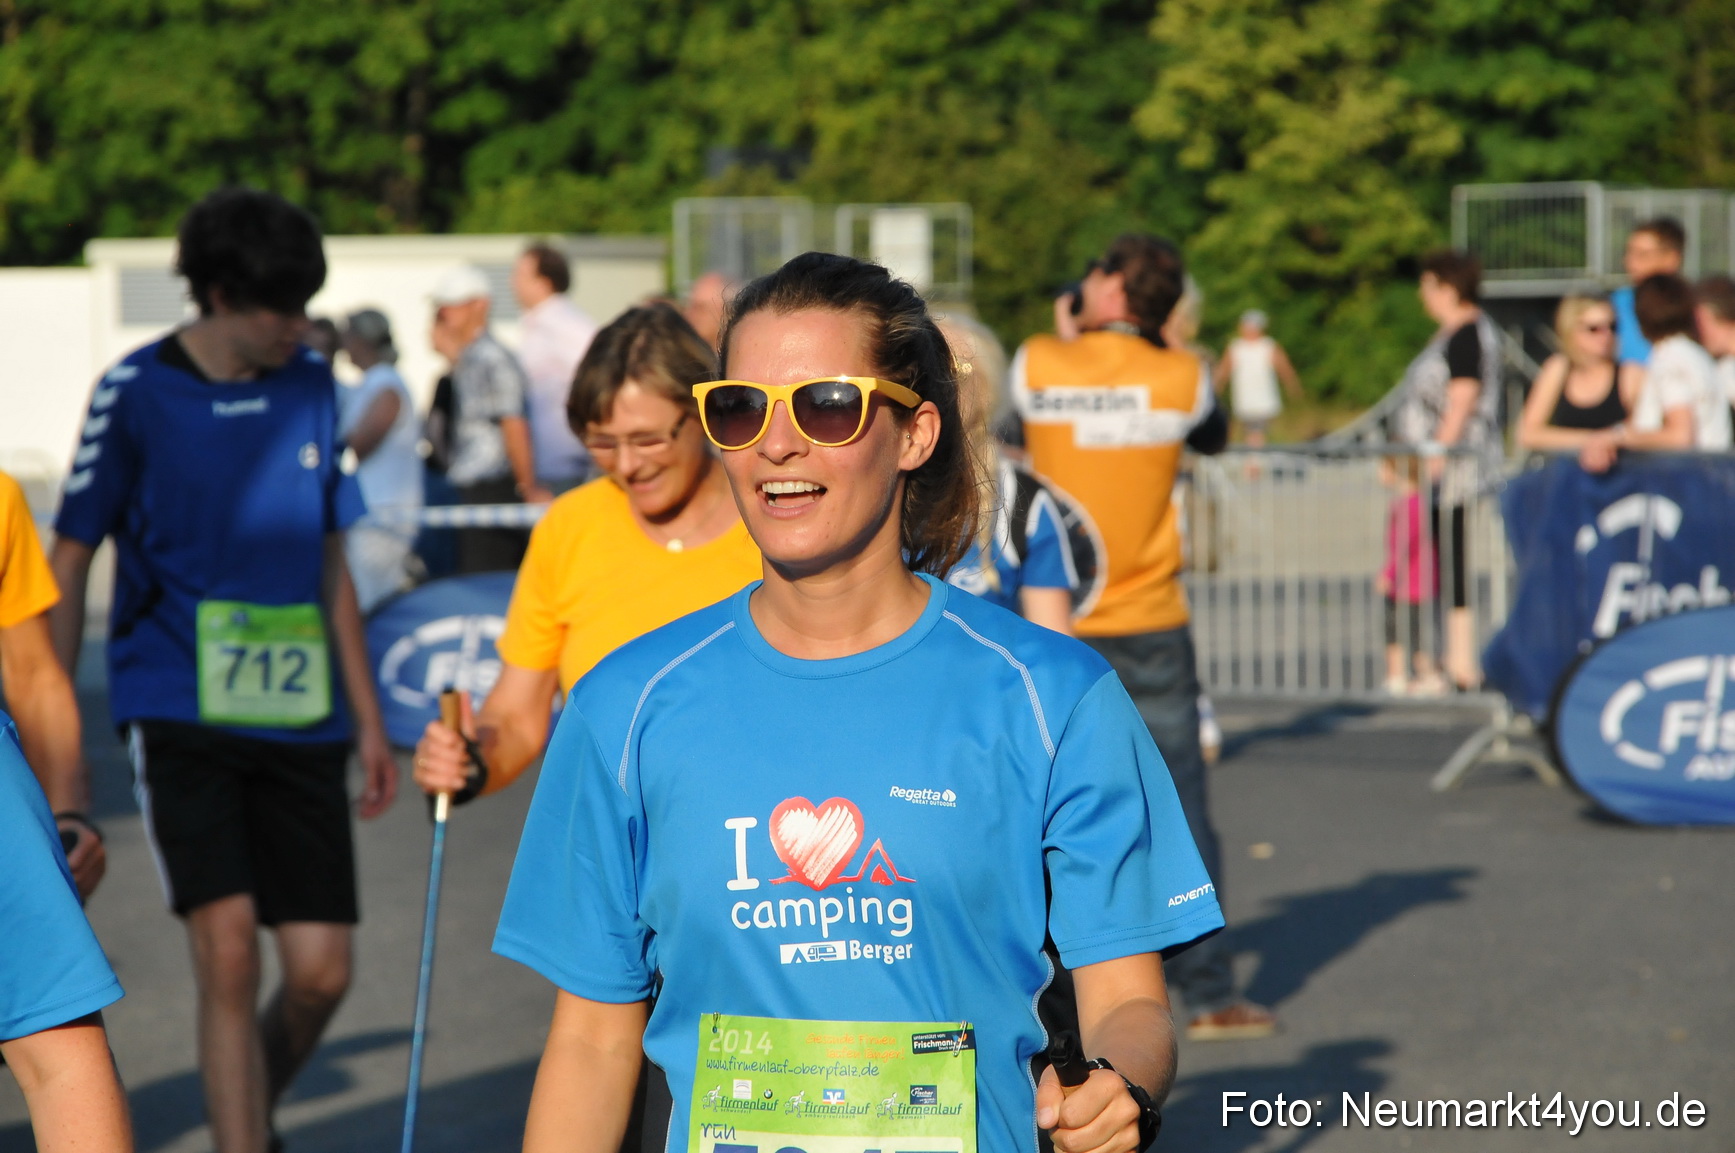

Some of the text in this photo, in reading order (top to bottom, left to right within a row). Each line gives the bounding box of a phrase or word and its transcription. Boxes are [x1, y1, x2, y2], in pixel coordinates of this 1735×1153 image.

[219, 645, 309, 693] 712
[889, 786, 941, 802] Regatta
[724, 816, 760, 891] I
[731, 886, 913, 939] camping
[849, 940, 913, 965] Berger
[709, 1029, 774, 1055] 2014
[706, 1055, 880, 1081] www.firmenlauf-oberpfalz.de
[720, 1096, 779, 1112] firmenlauf
[804, 1101, 871, 1115] firmenlauf
[898, 1103, 963, 1116] firmenlauf
[701, 1122, 737, 1141] run
